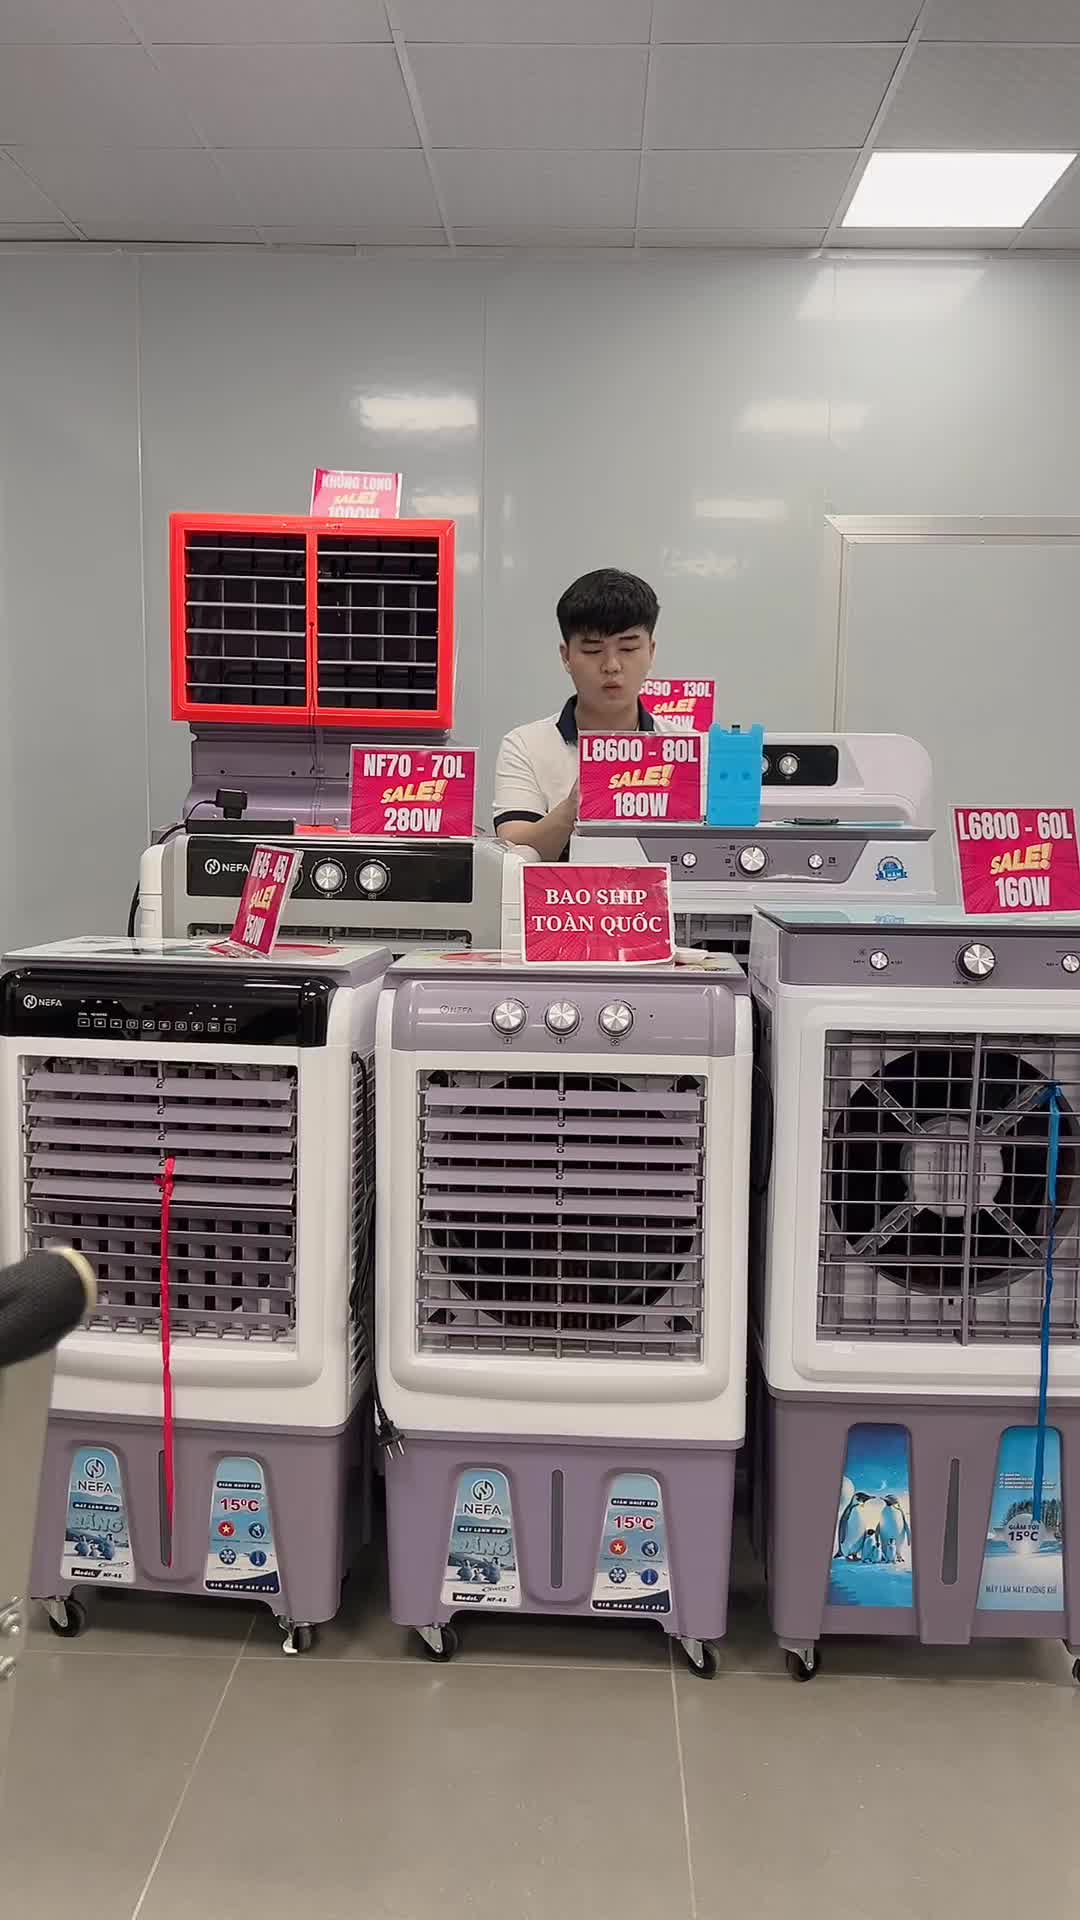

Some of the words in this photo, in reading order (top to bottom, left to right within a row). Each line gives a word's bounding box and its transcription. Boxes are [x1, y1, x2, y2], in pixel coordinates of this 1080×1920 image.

[682, 681, 712, 698] 130L
[652, 698, 696, 714] SALE!
[582, 738, 643, 762] L8600
[662, 739, 698, 763] 80L
[363, 754, 411, 777] NF70
[431, 755, 465, 779] 70L
[608, 764, 675, 789] SALE!
[380, 779, 448, 803] SALE!
[613, 792, 668, 817] 180W
[383, 807, 442, 832] 280W
[958, 811, 1020, 840] L6800
[1037, 811, 1073, 839] 60L
[221, 863, 250, 873] NEFA
[990, 842, 1053, 875] SALE!
[545, 888, 591, 905] BAO
[596, 888, 647, 905] SHIP
[995, 876, 1050, 907] 160W
[531, 912, 595, 932] TOÀN
[600, 912, 662, 937] QUỐC
[38, 998, 62, 1007] NEFA
[78, 1480, 113, 1493] NEFA
[463, 1503, 502, 1515] NEFA
